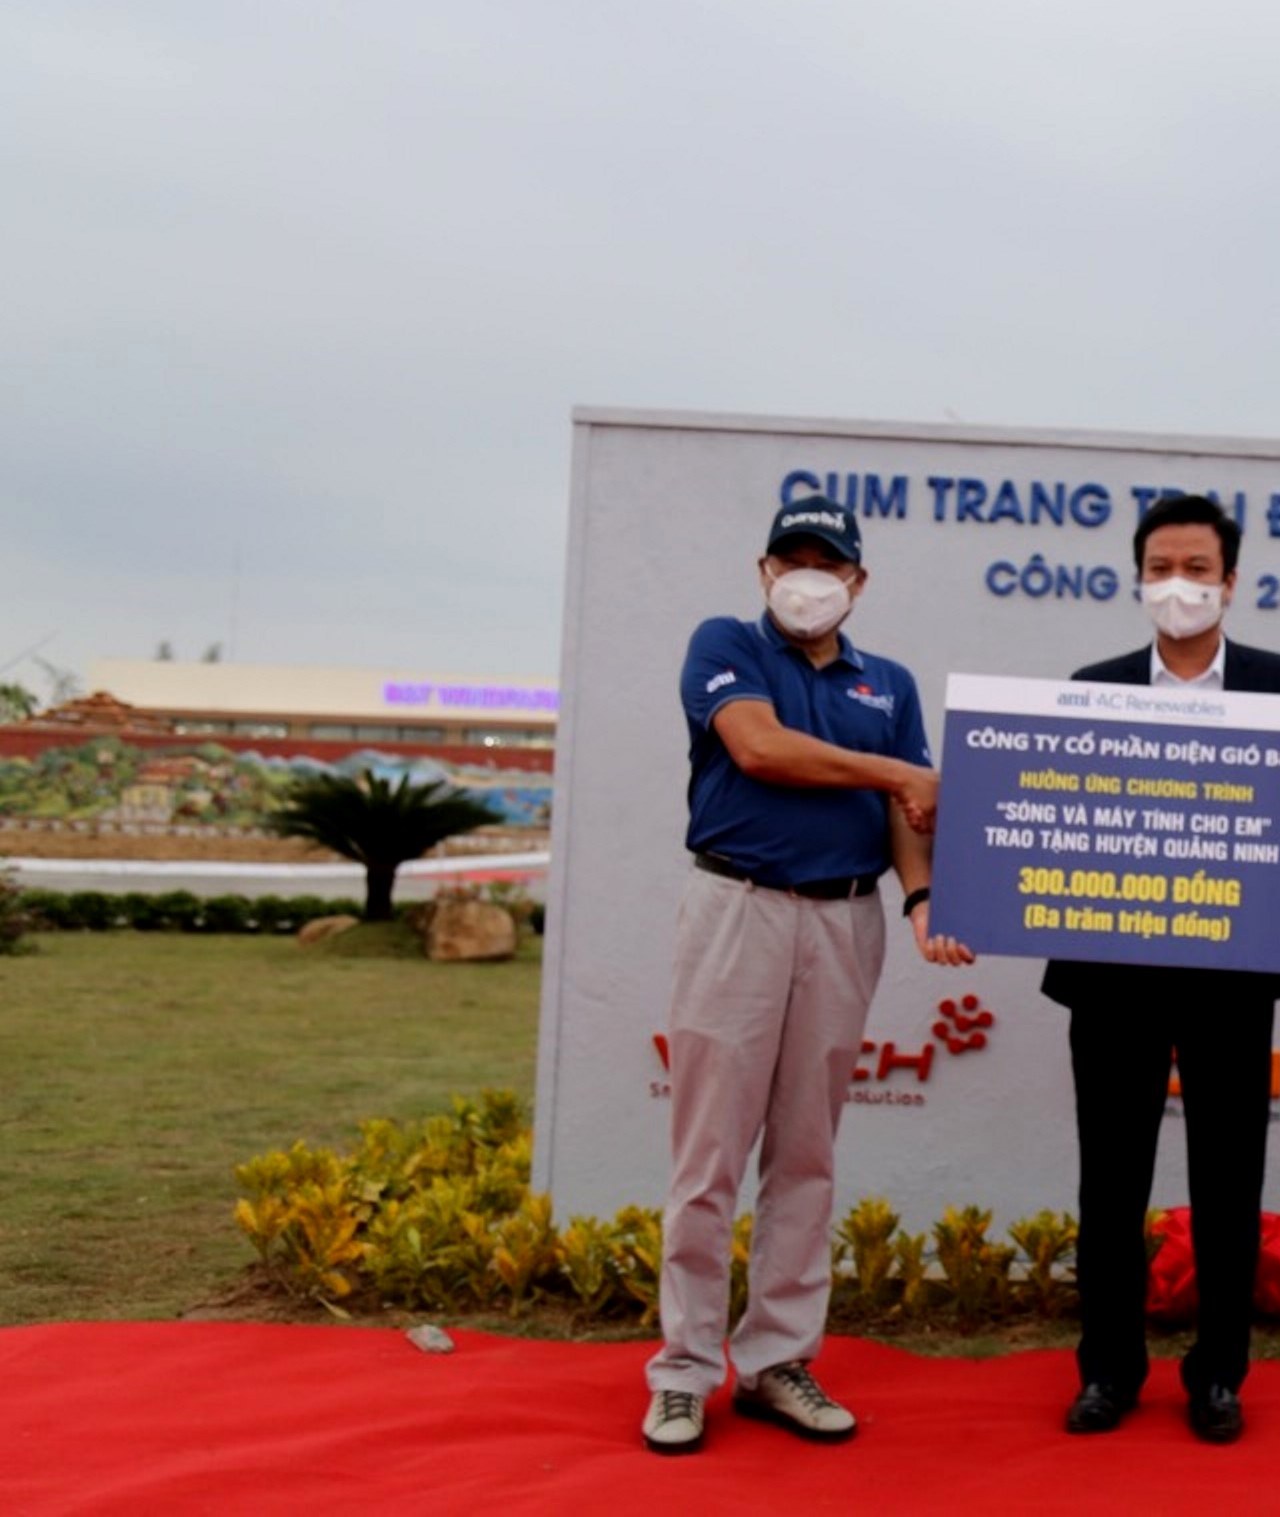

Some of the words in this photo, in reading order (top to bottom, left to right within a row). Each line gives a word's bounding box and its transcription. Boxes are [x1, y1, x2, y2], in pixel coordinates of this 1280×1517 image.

[928, 477, 1112, 528] TRANG
[986, 554, 1119, 601] CÔNG
[967, 728, 1029, 750] CÔNG
[1034, 734, 1060, 751] TY
[1100, 734, 1160, 759] PHẦN
[1165, 741, 1216, 765] ĐIỆN
[1221, 745, 1260, 766] GIÓ
[1063, 804, 1088, 825] VÀ
[1094, 806, 1136, 828] MÁY
[1142, 811, 1185, 831] TÍNH
[1191, 815, 1228, 834] CHO
[985, 827, 1033, 848] TRAO
[1096, 834, 1158, 859] HUYỆN
[1234, 844, 1279, 864] NINH
[1019, 868, 1167, 901] 300.000.000
[1173, 870, 1240, 907] ĐỒNG
[1025, 904, 1059, 930] (Ba
[1065, 907, 1113, 932] trăm
[1119, 910, 1166, 939] triệu
[1172, 912, 1230, 941] đồng)
[845, 1087, 925, 1106] olution
